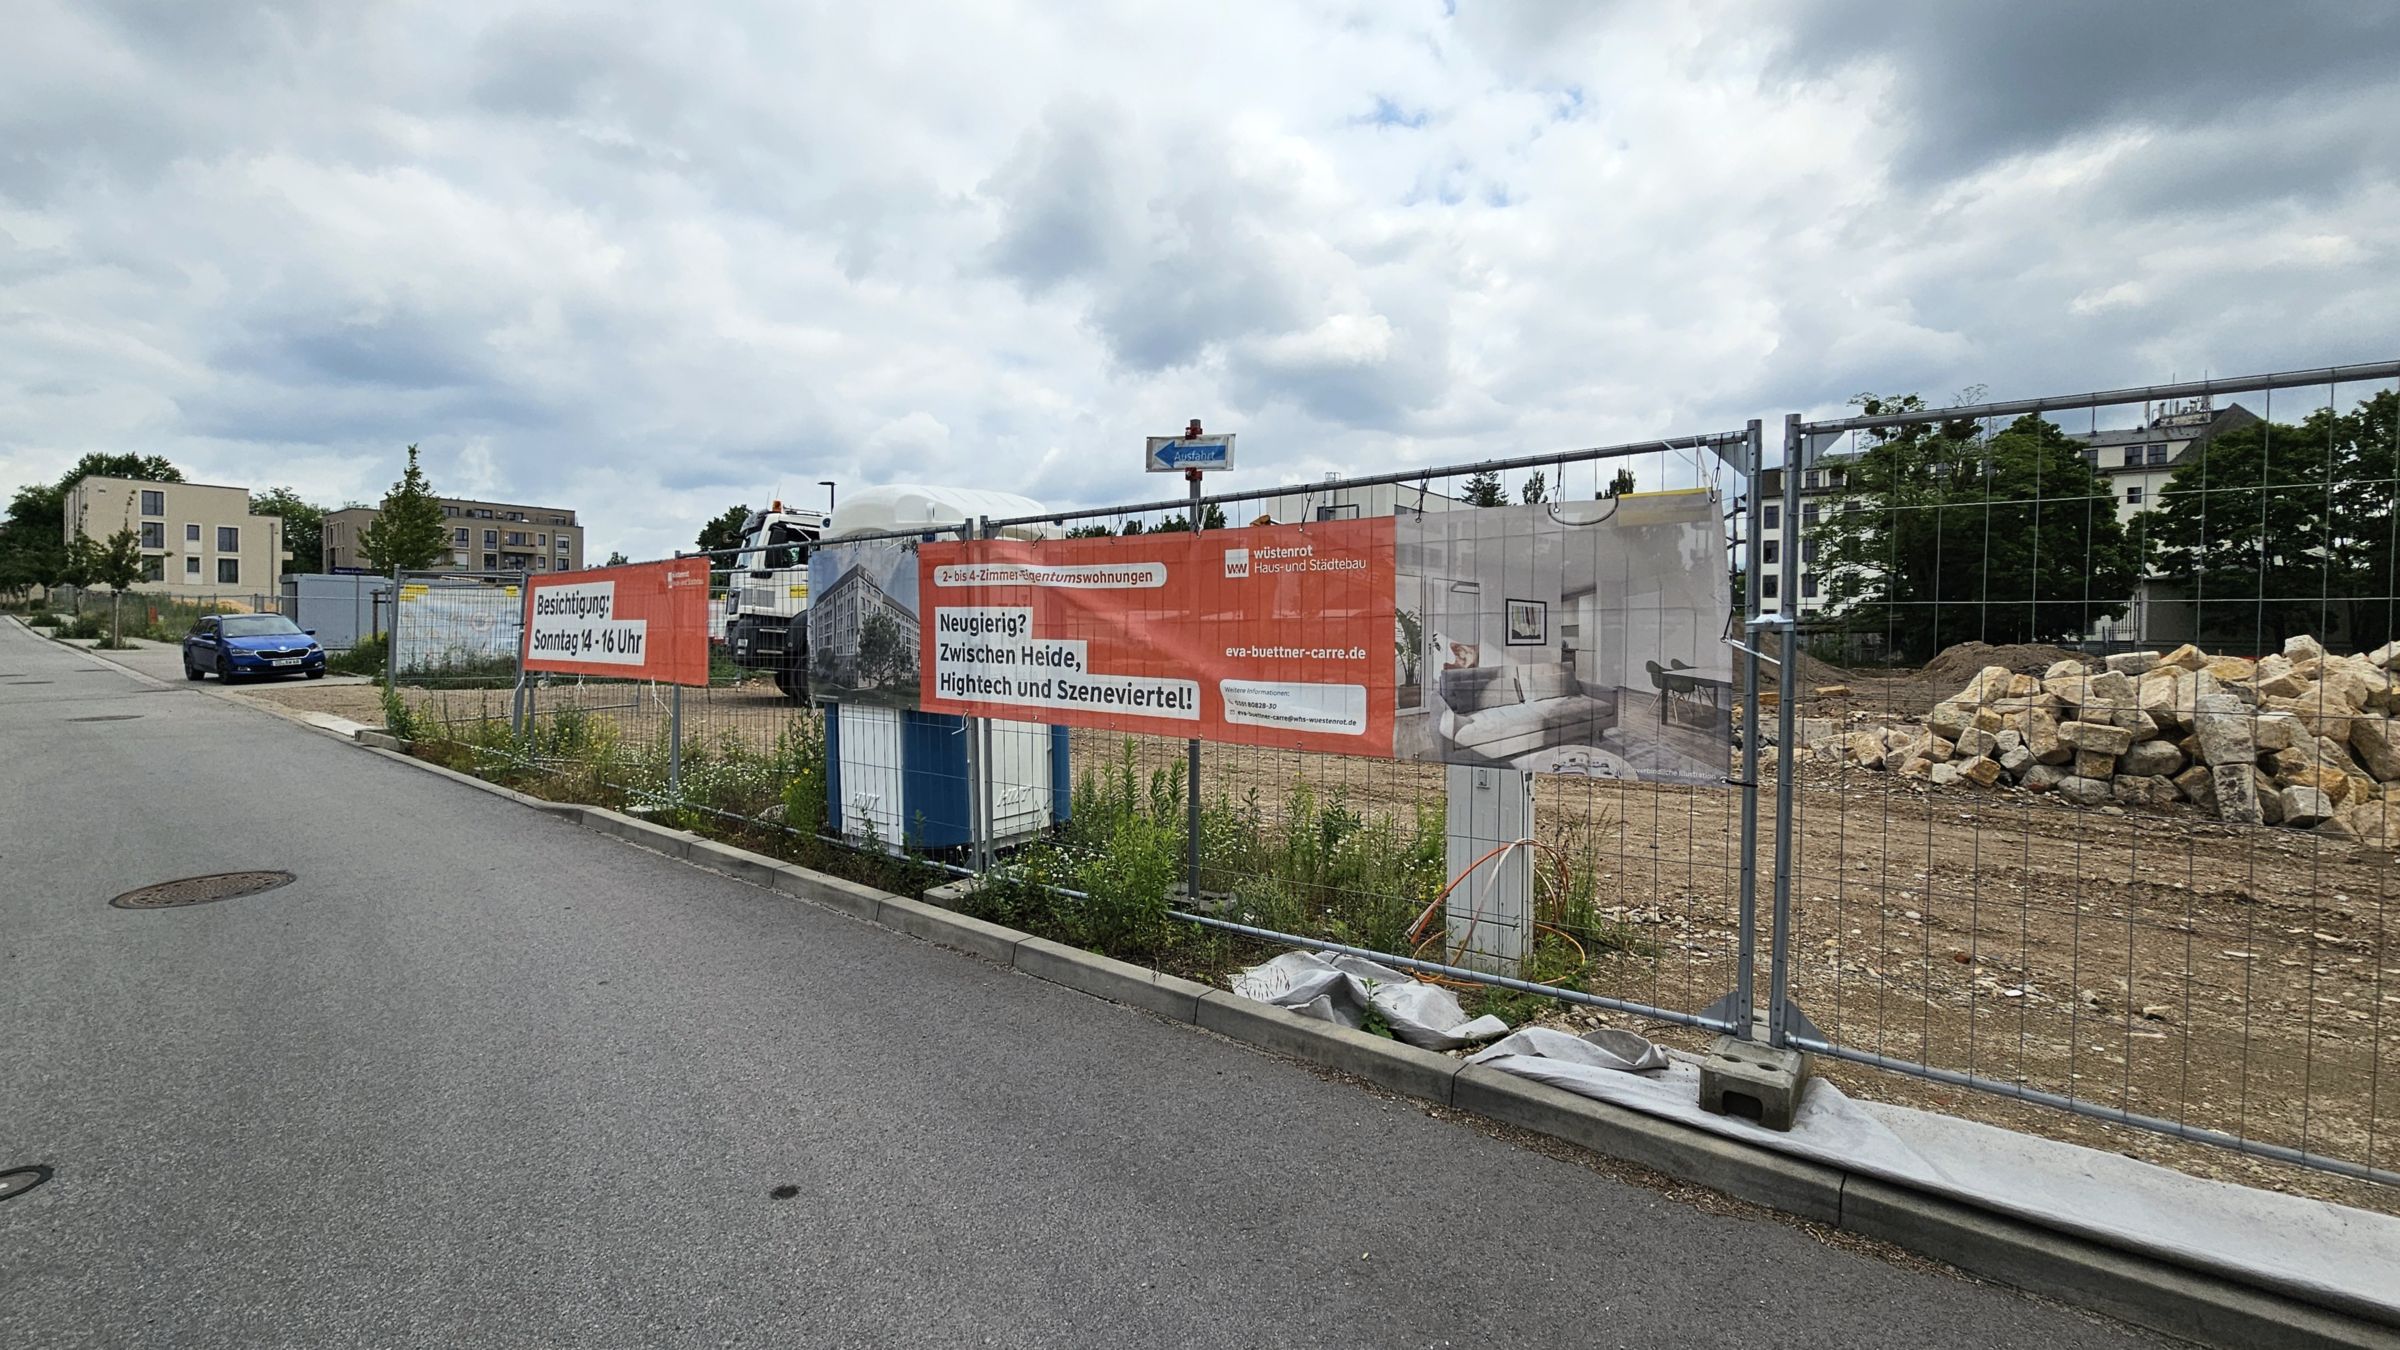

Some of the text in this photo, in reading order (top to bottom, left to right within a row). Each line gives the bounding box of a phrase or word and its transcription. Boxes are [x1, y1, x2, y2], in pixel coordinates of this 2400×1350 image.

[1174, 450, 1216, 461] Ausfahrt
[1253, 545, 1314, 559] wüstenrot
[1285, 560, 1307, 572] und
[1309, 557, 1367, 572] Städtebau
[942, 571, 953, 582] 2-
[953, 569, 967, 582] bis
[537, 590, 610, 619] Besichtigung:
[940, 613, 1027, 637] Neugierig?
[534, 629, 578, 656] Sonntag
[580, 628, 593, 652] 14
[602, 628, 614, 653] 16
[617, 628, 642, 654] Uhr
[940, 642, 1081, 672] Zwischen Heide,
[1225, 645, 1366, 659] eva-buettner-carre.de
[940, 672, 1193, 710] Hightech und Szeneviertel!
[1246, 688, 1290, 697] Informationen:
